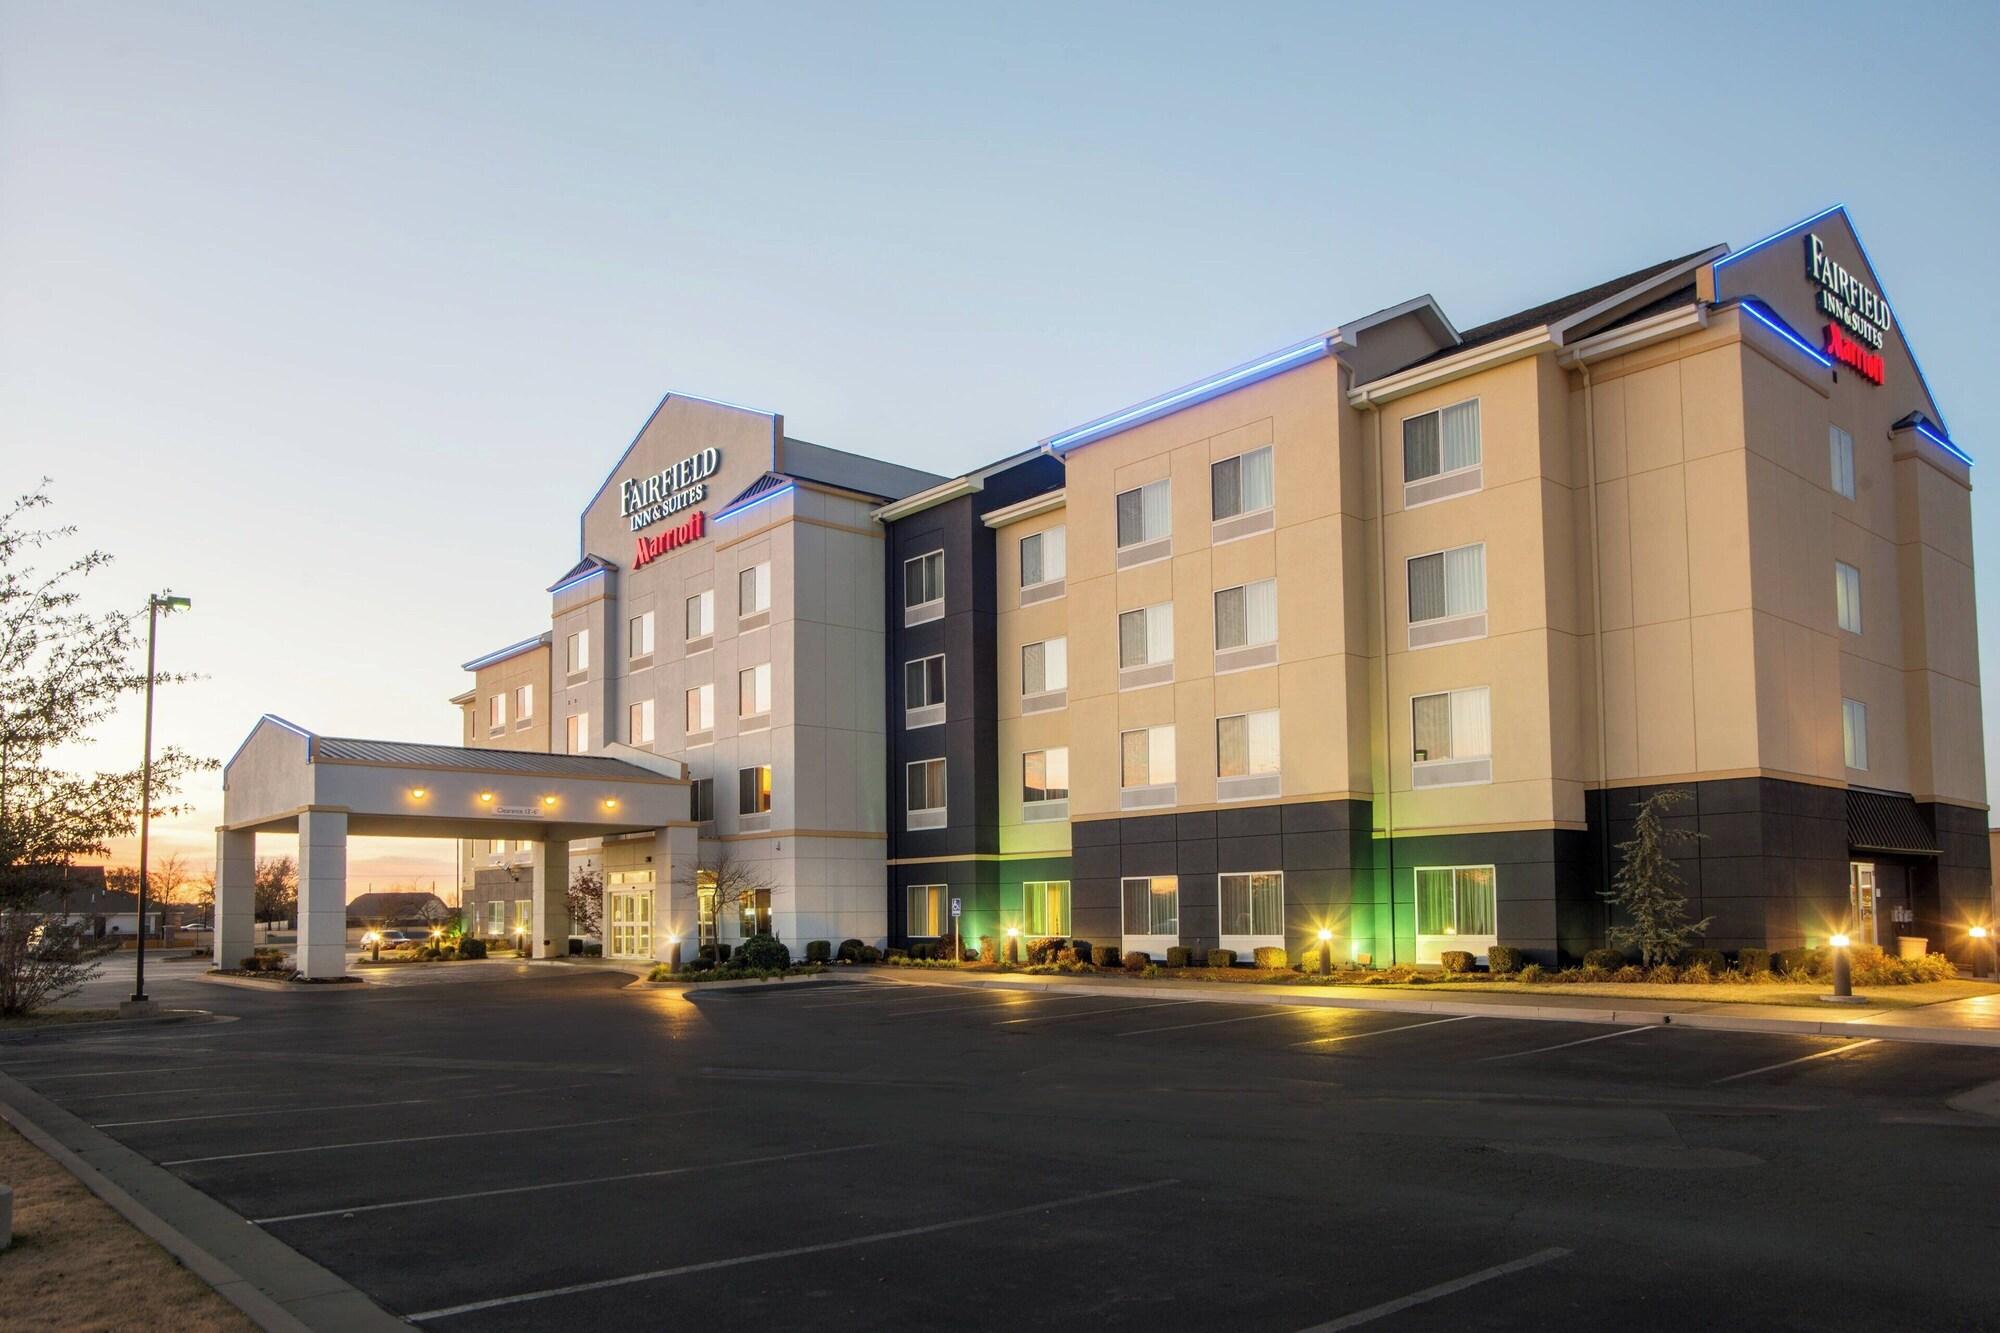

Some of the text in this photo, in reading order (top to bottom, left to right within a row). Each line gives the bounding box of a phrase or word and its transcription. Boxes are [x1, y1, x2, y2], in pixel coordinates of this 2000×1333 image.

[1810, 233, 1891, 331] FAIRFIELD
[619, 447, 718, 517] FAIRFIELD
[632, 511, 705, 570] Marriott
